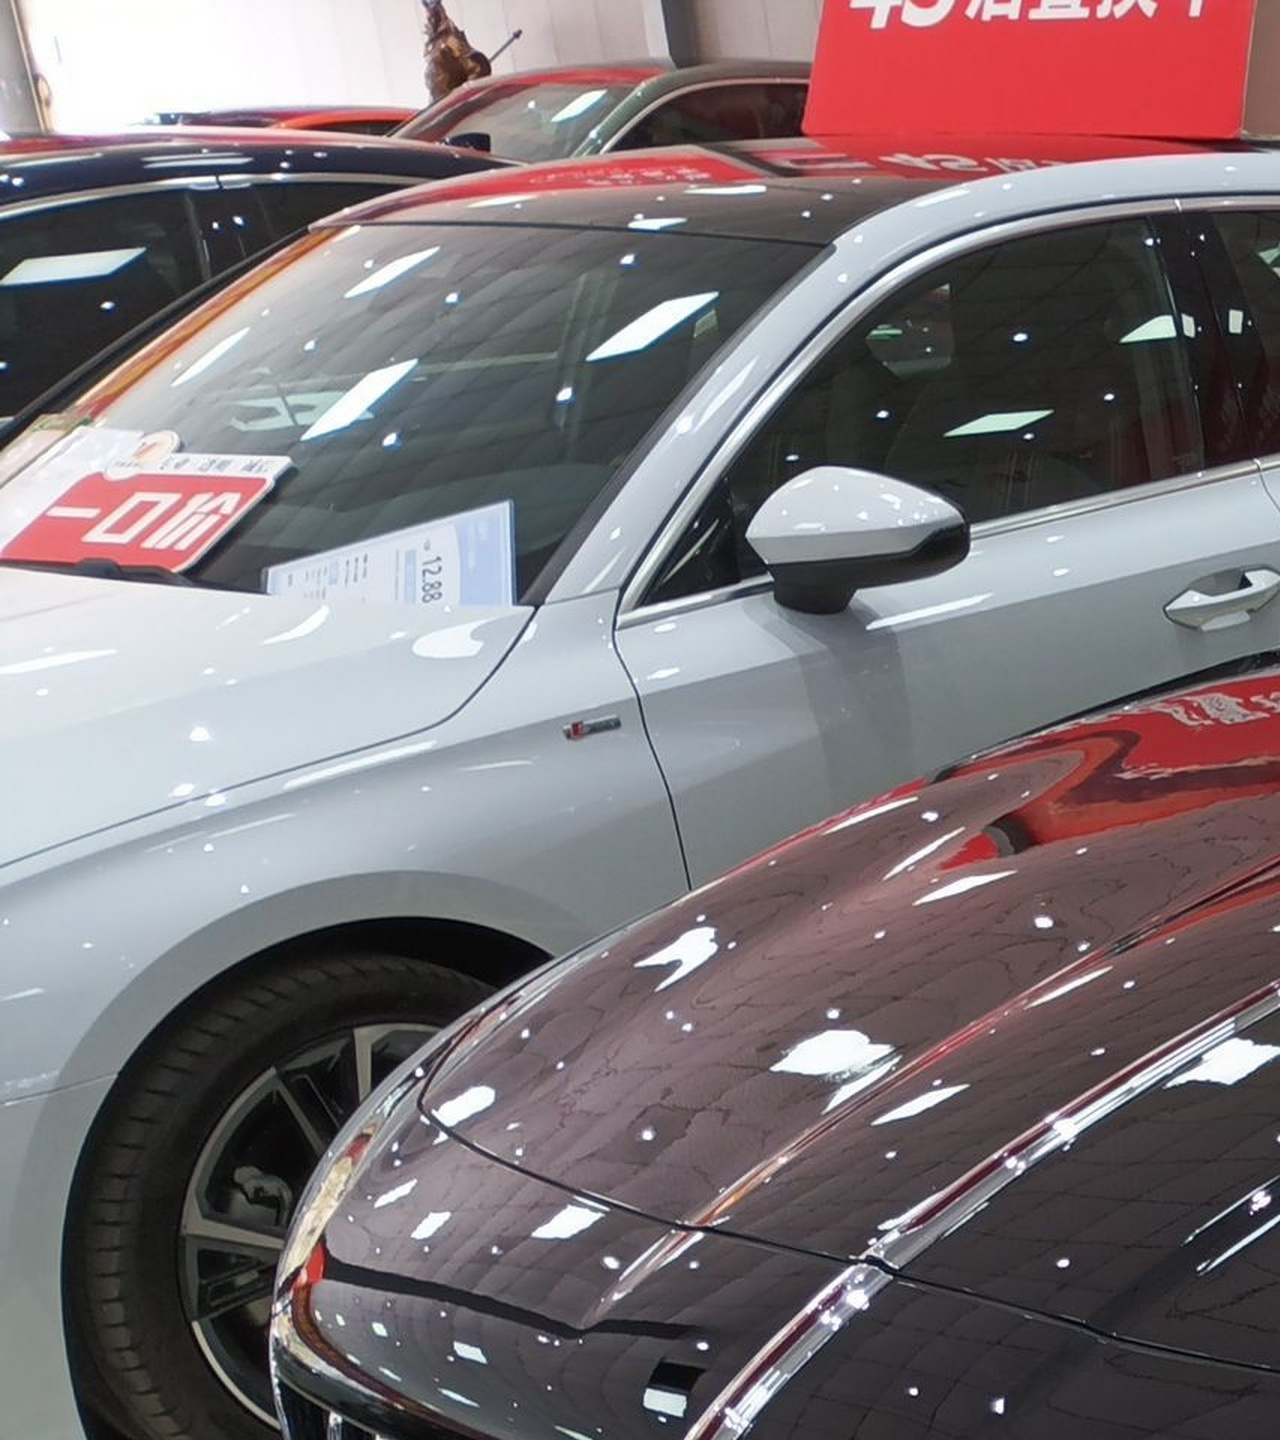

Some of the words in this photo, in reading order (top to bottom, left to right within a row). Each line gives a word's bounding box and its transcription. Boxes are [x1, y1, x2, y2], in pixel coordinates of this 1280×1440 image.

[47, 491, 242, 550] 一口价
[422, 556, 442, 603] 12.88
